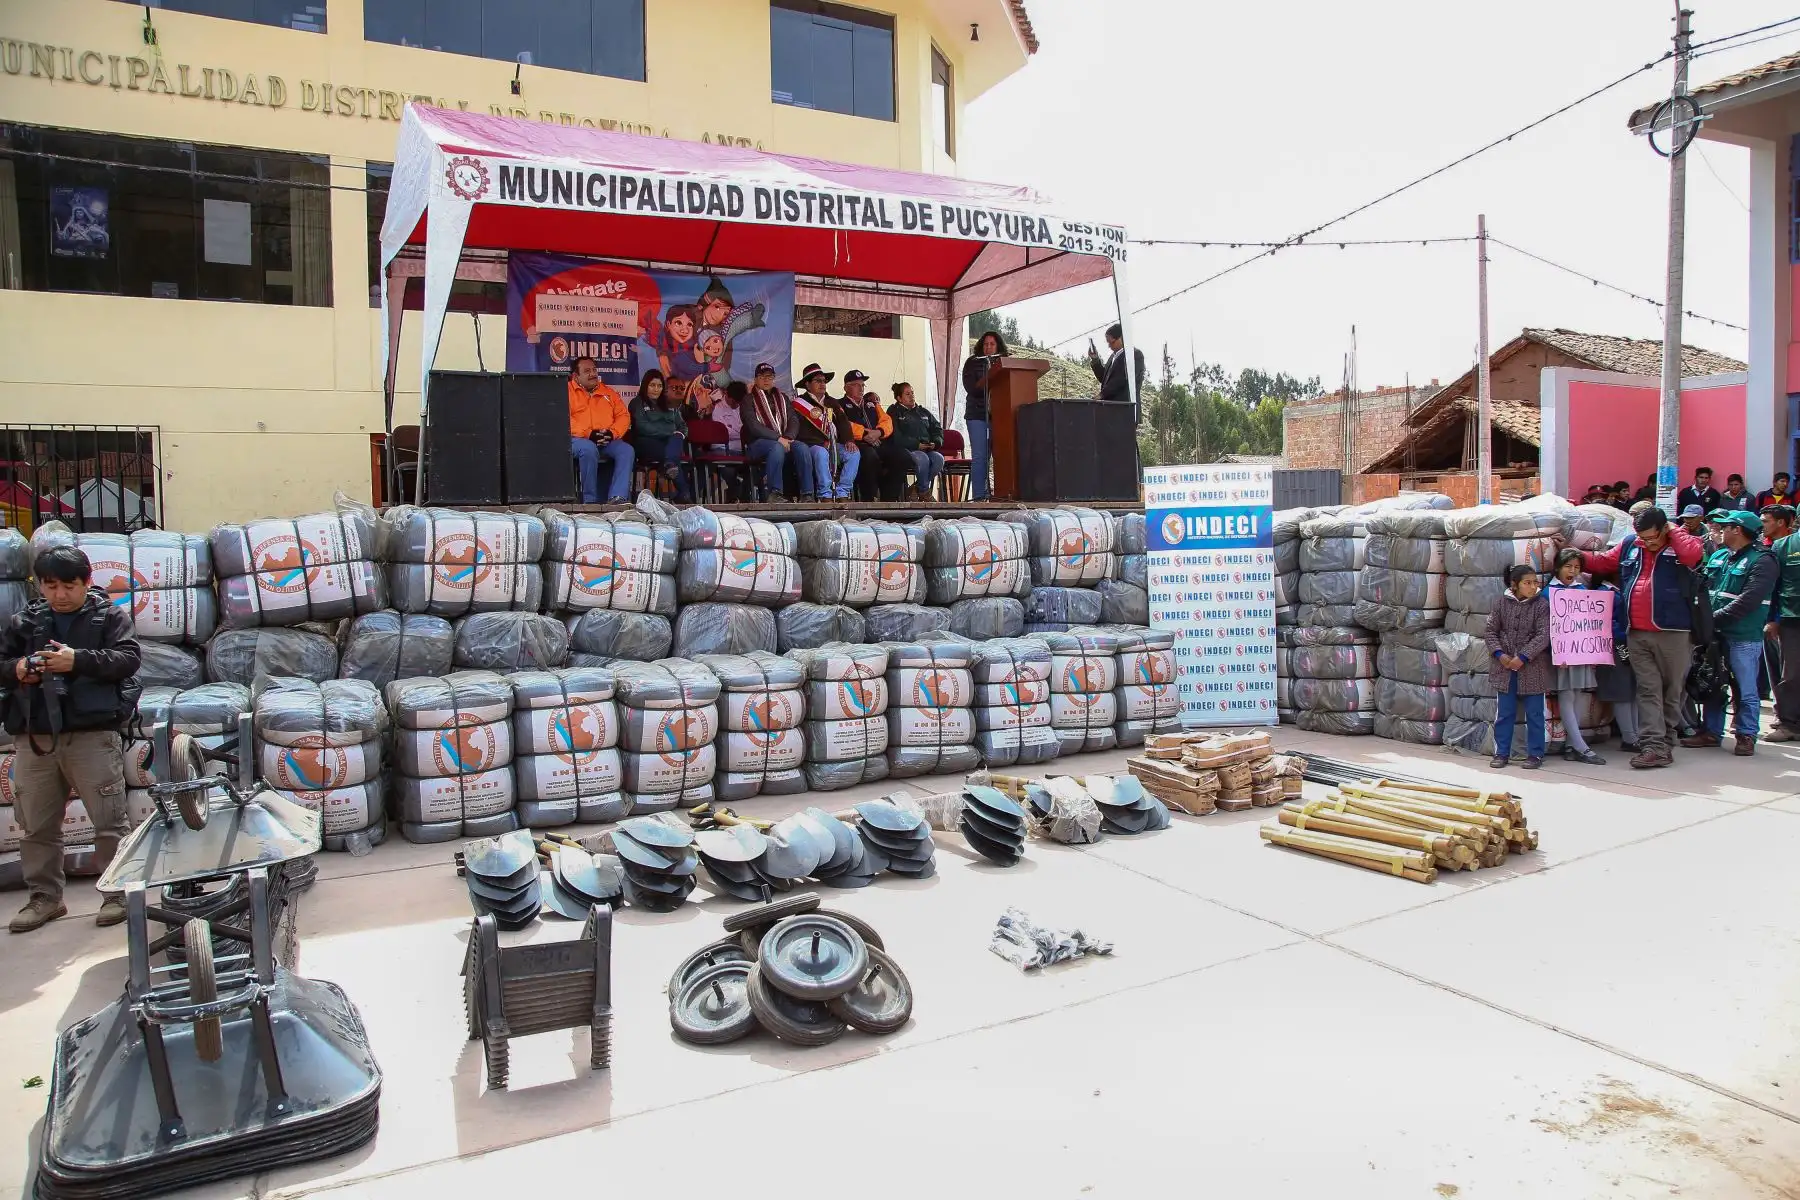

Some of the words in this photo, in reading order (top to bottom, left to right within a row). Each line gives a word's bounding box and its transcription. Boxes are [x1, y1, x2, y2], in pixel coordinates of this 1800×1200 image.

[0, 36, 287, 107] UNICIPALIDAD
[499, 165, 744, 218] MUNICIPALIDAD
[755, 186, 893, 230] DISTRITAL
[902, 201, 934, 231] DE
[941, 206, 1053, 245] PUCYURA
[1059, 234, 1093, 252] 2015
[570, 341, 628, 359] INDECI
[1180, 473, 1208, 483] INDECI
[1222, 472, 1250, 480] INDECI
[1157, 492, 1186, 501] INDECI
[1199, 491, 1227, 499] INDECI
[1241, 489, 1269, 498] INDECI
[1187, 515, 1258, 536] INDECI
[1183, 556, 1211, 564] INDECI
[1224, 555, 1252, 563] INDECI
[1161, 575, 1188, 583] INDECI
[1202, 573, 1229, 582] INDECI
[1243, 573, 1271, 581] INDECI
[1184, 592, 1212, 601] INDECI
[1225, 591, 1253, 600] INDECI
[1162, 611, 1189, 620] INDECI
[1203, 610, 1231, 619] INDECI
[1243, 609, 1272, 618] INDECI
[1185, 629, 1213, 637] INDECI
[1226, 628, 1254, 636] INDECI
[1173, 647, 1191, 656] DECI
[1204, 647, 1232, 655] INDECI
[1244, 646, 1273, 654] INDECI
[1186, 665, 1214, 674] INDECI
[1227, 664, 1255, 672] INDECI
[1205, 682, 1233, 691] INDECI
[1246, 682, 1274, 690] INDECI
[1187, 701, 1215, 710] INDECI
[1228, 700, 1256, 709] INDECI
[838, 718, 881, 728] INDCI
[743, 748, 793, 757] INDECI
[552, 765, 609, 777] INDECI
[437, 781, 499, 794] INDECI
